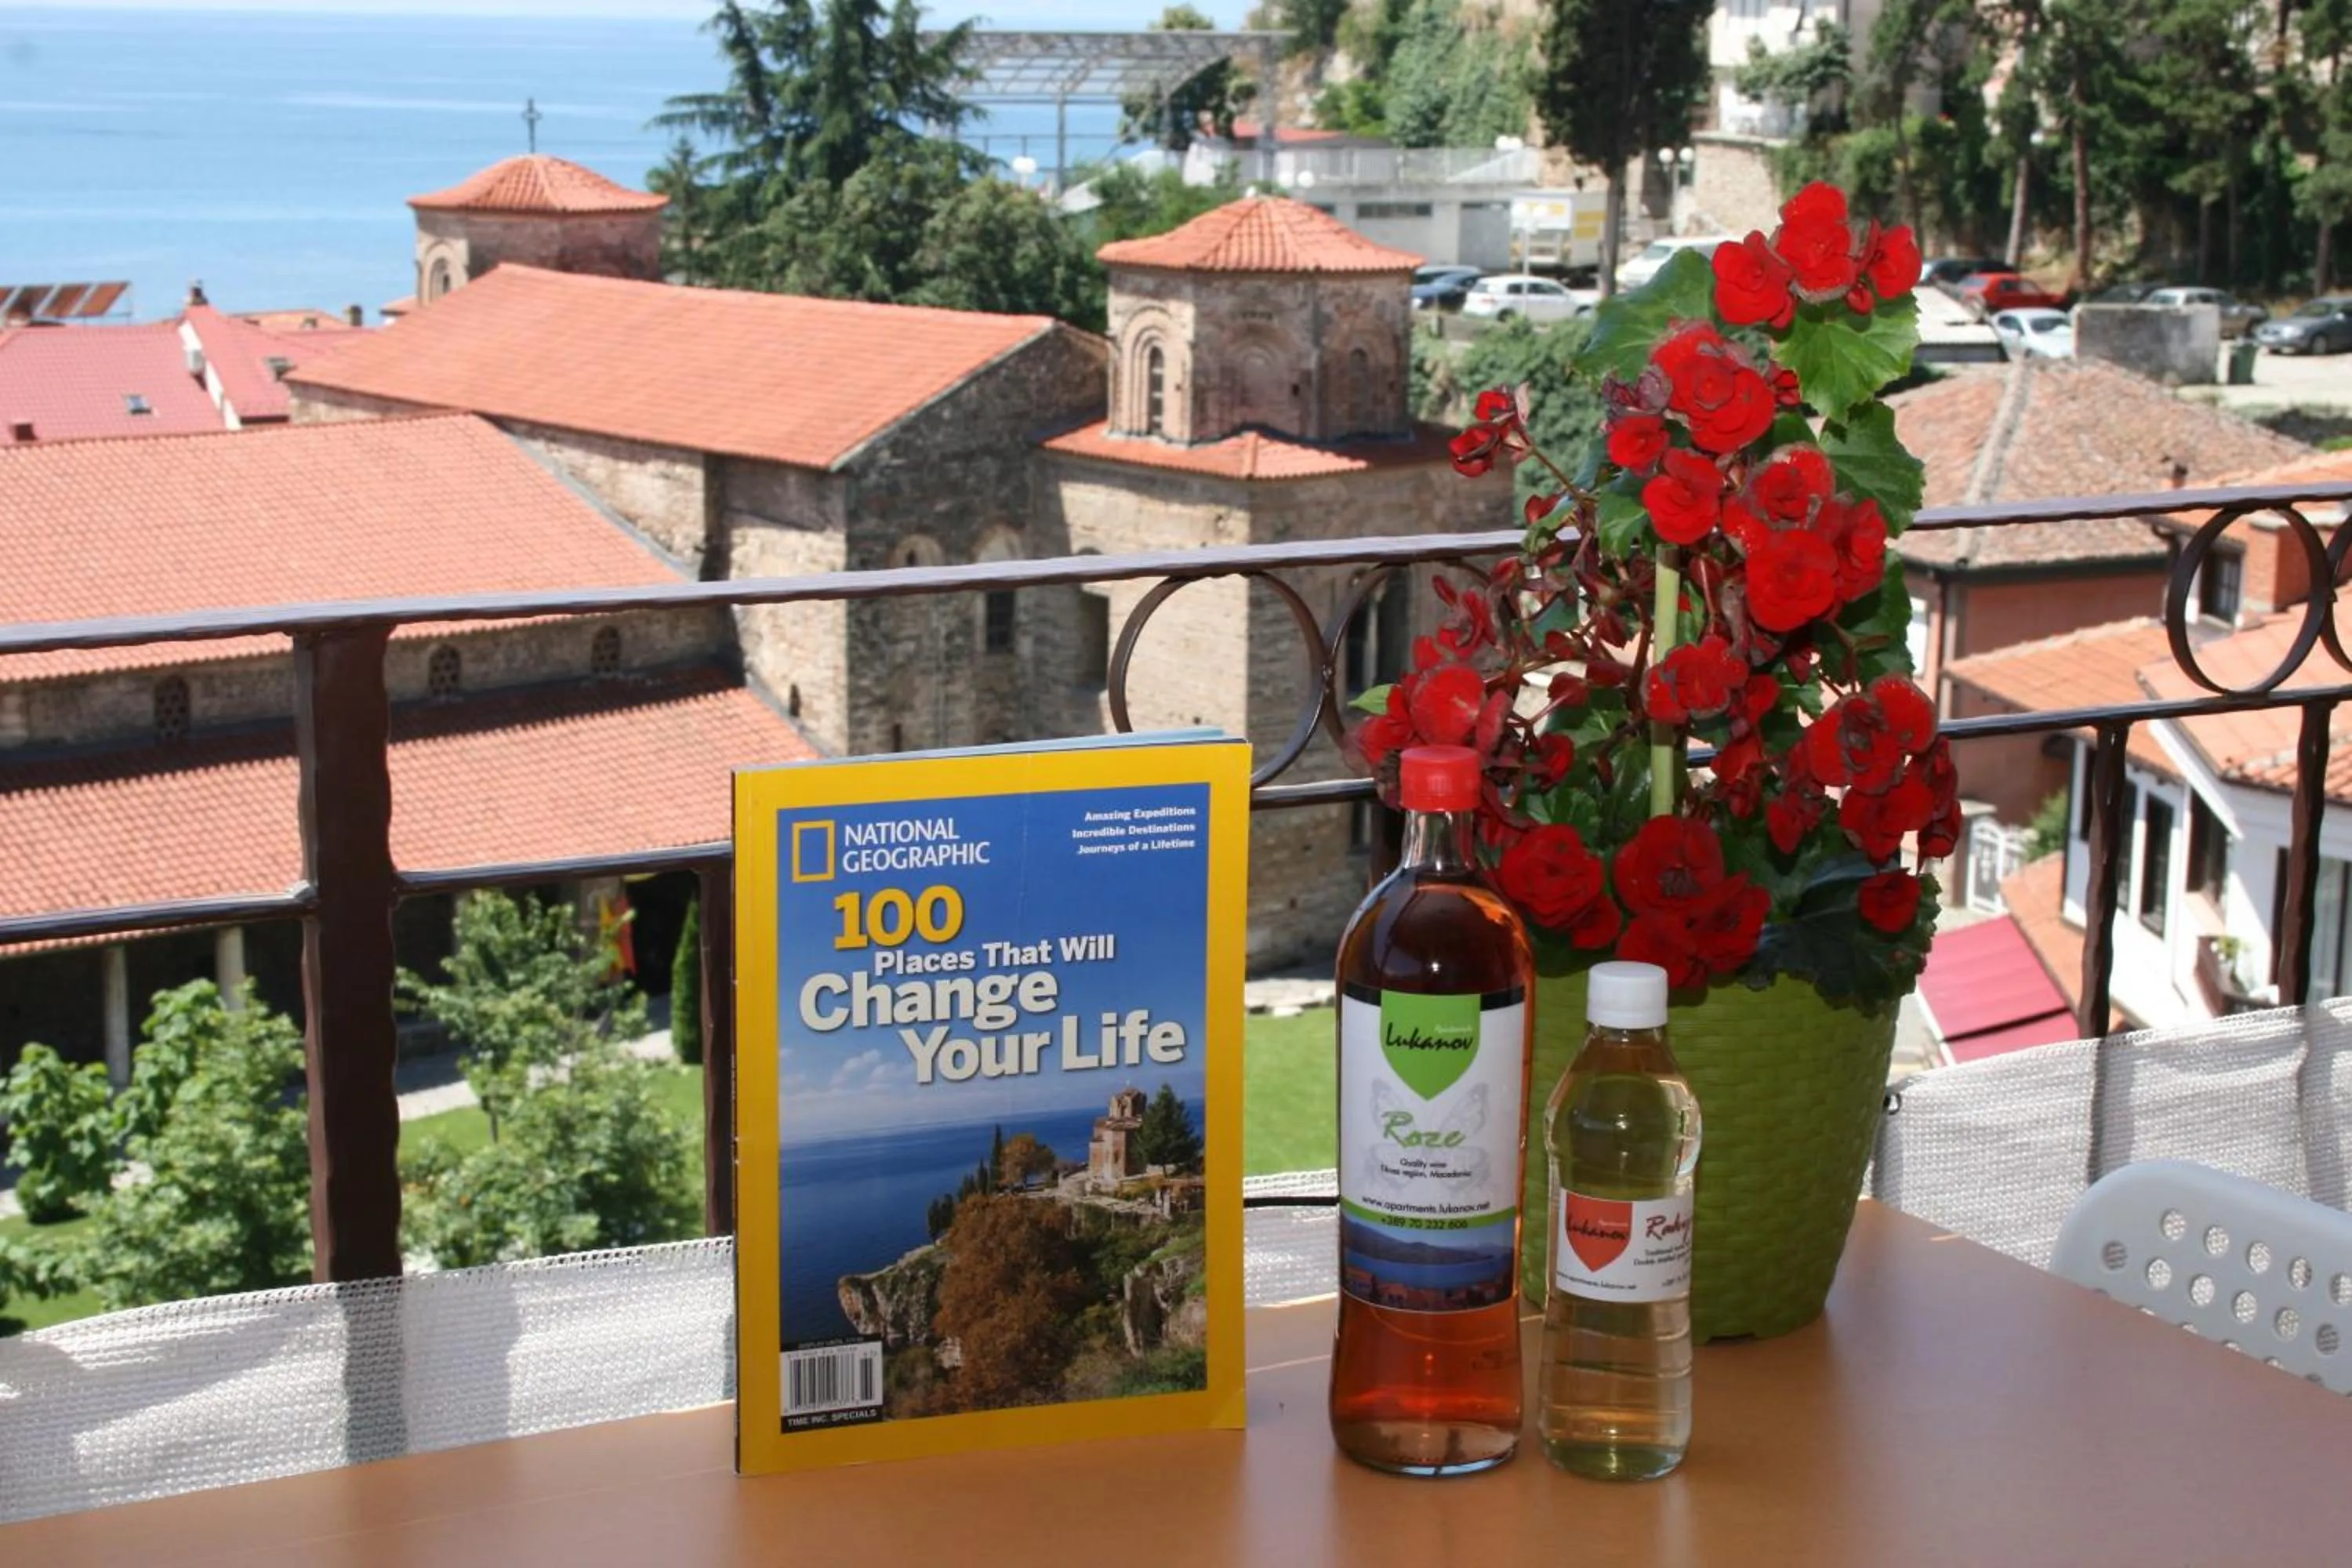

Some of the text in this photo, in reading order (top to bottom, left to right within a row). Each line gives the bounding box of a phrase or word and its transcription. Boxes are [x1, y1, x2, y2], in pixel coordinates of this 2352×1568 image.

[1084, 807, 1196, 822] Amazing Expeditions
[844, 818, 960, 847] NATIONAL
[1072, 823, 1196, 838] Incredible Destinations
[843, 842, 990, 873] GEOGRAPHIC
[1076, 844, 1125, 855] Journeys
[1128, 841, 1140, 851] of
[1151, 838, 1195, 850] Lifetime
[833, 884, 964, 949] 100
[874, 934, 1116, 977] Places That Will
[799, 971, 1058, 1032] Change
[898, 1009, 1186, 1084] Your Life
[1385, 1022, 1474, 1051] Lukanov
[1381, 1110, 1467, 1149] Roze
[1399, 1157, 1428, 1169] Quality
[1430, 1168, 1472, 1178] Macedonia
[787, 1417, 809, 1427] TIME
[831, 1408, 877, 1421] SPECIALS
